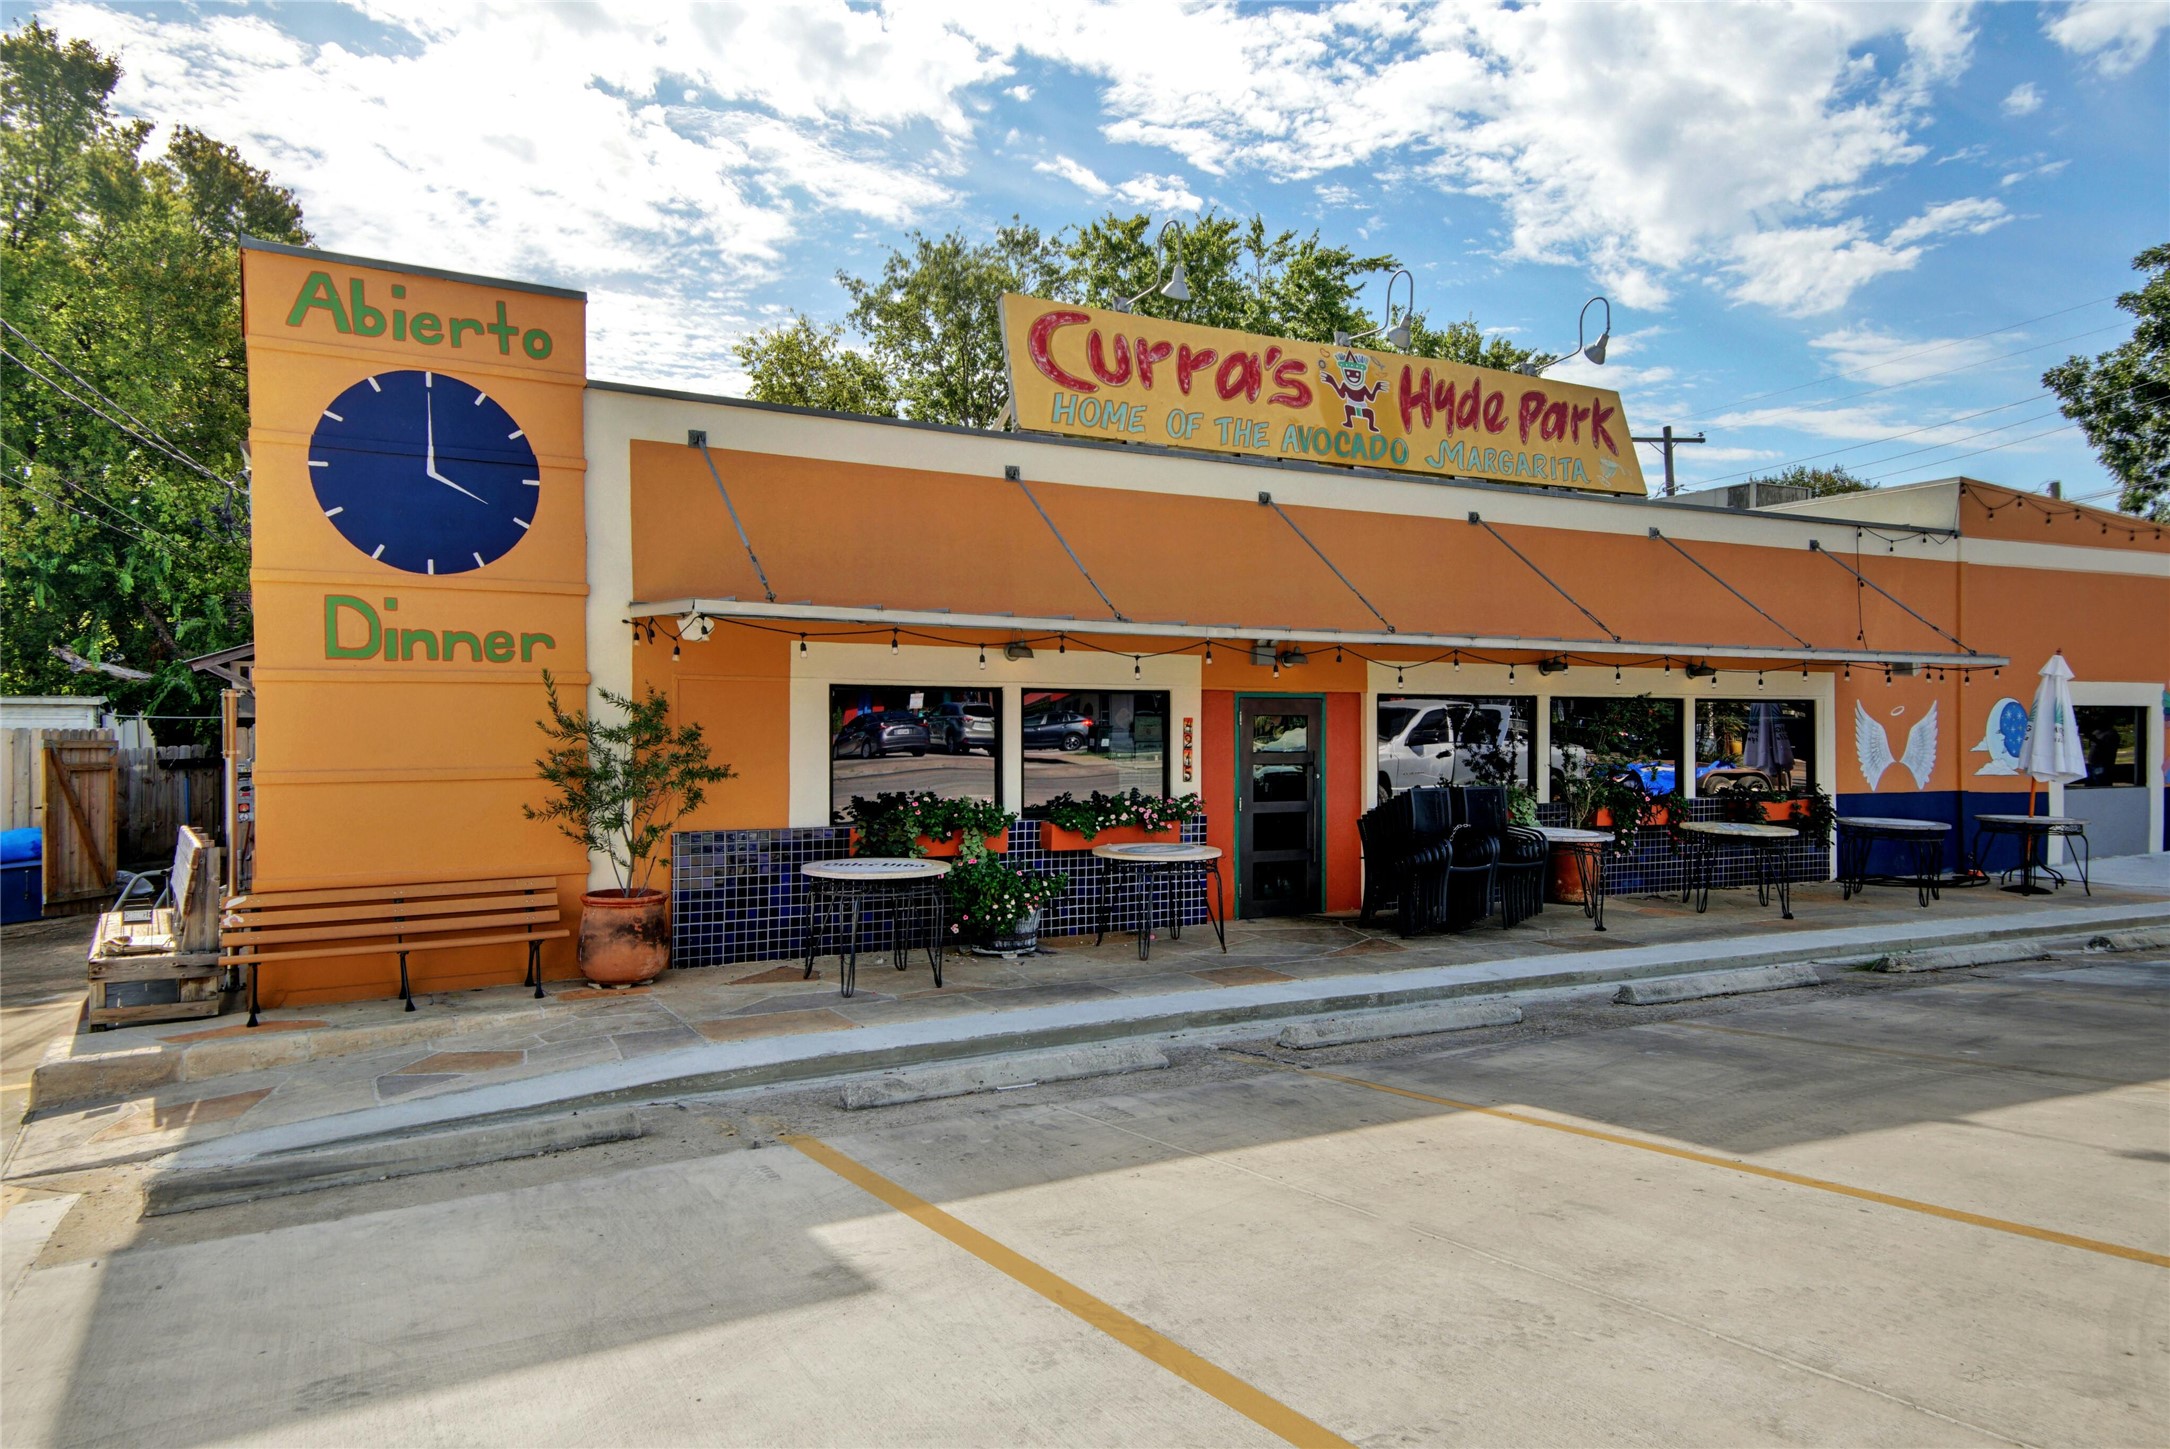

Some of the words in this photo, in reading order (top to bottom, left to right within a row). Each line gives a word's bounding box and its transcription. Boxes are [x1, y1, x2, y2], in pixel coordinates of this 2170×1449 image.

[285, 271, 553, 360] Abierto
[1028, 310, 1313, 409] Curra's
[1398, 363, 1510, 438] Hyde
[1518, 389, 1619, 457] Park
[1051, 392, 1148, 434] HOME
[1166, 409, 1204, 440] OF
[1214, 416, 1270, 448] THE
[1281, 423, 1409, 466] AVOCADO
[1425, 439, 1591, 485] MARGARITA
[324, 594, 556, 662] Dinner
